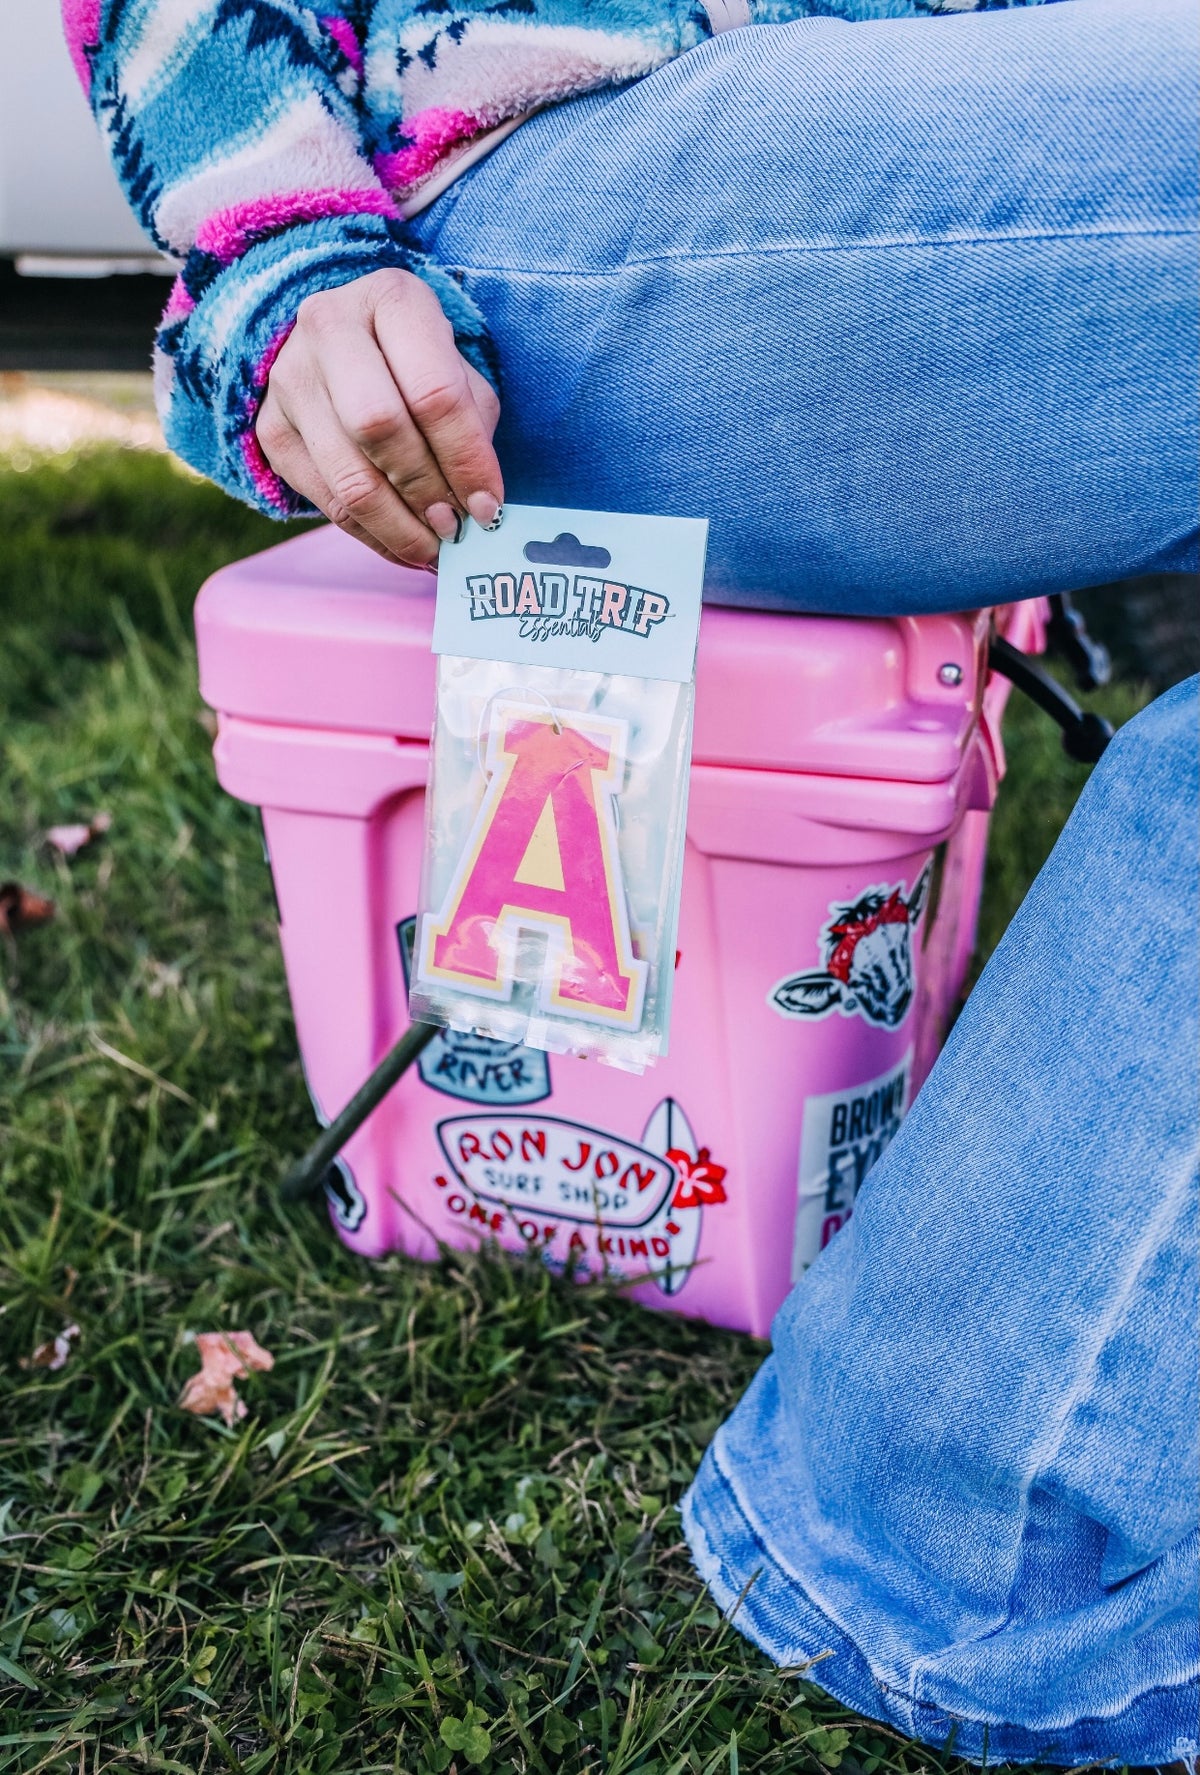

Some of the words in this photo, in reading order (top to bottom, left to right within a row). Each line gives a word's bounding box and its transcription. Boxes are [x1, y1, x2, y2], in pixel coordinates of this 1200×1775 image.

[466, 572, 569, 621] ROAD
[573, 575, 670, 638] TRIP
[518, 606, 606, 642] Essentials
[425, 707, 637, 1023] A
[435, 1053, 532, 1091] RIVER
[459, 1130, 546, 1163] RON
[561, 1142, 656, 1192] JON
[484, 1168, 543, 1192] SURF
[558, 1181, 628, 1210] SHOP
[447, 1194, 505, 1232] ONE
[519, 1220, 555, 1241] OF
[570, 1232, 586, 1252] A
[598, 1236, 670, 1257] KIND
